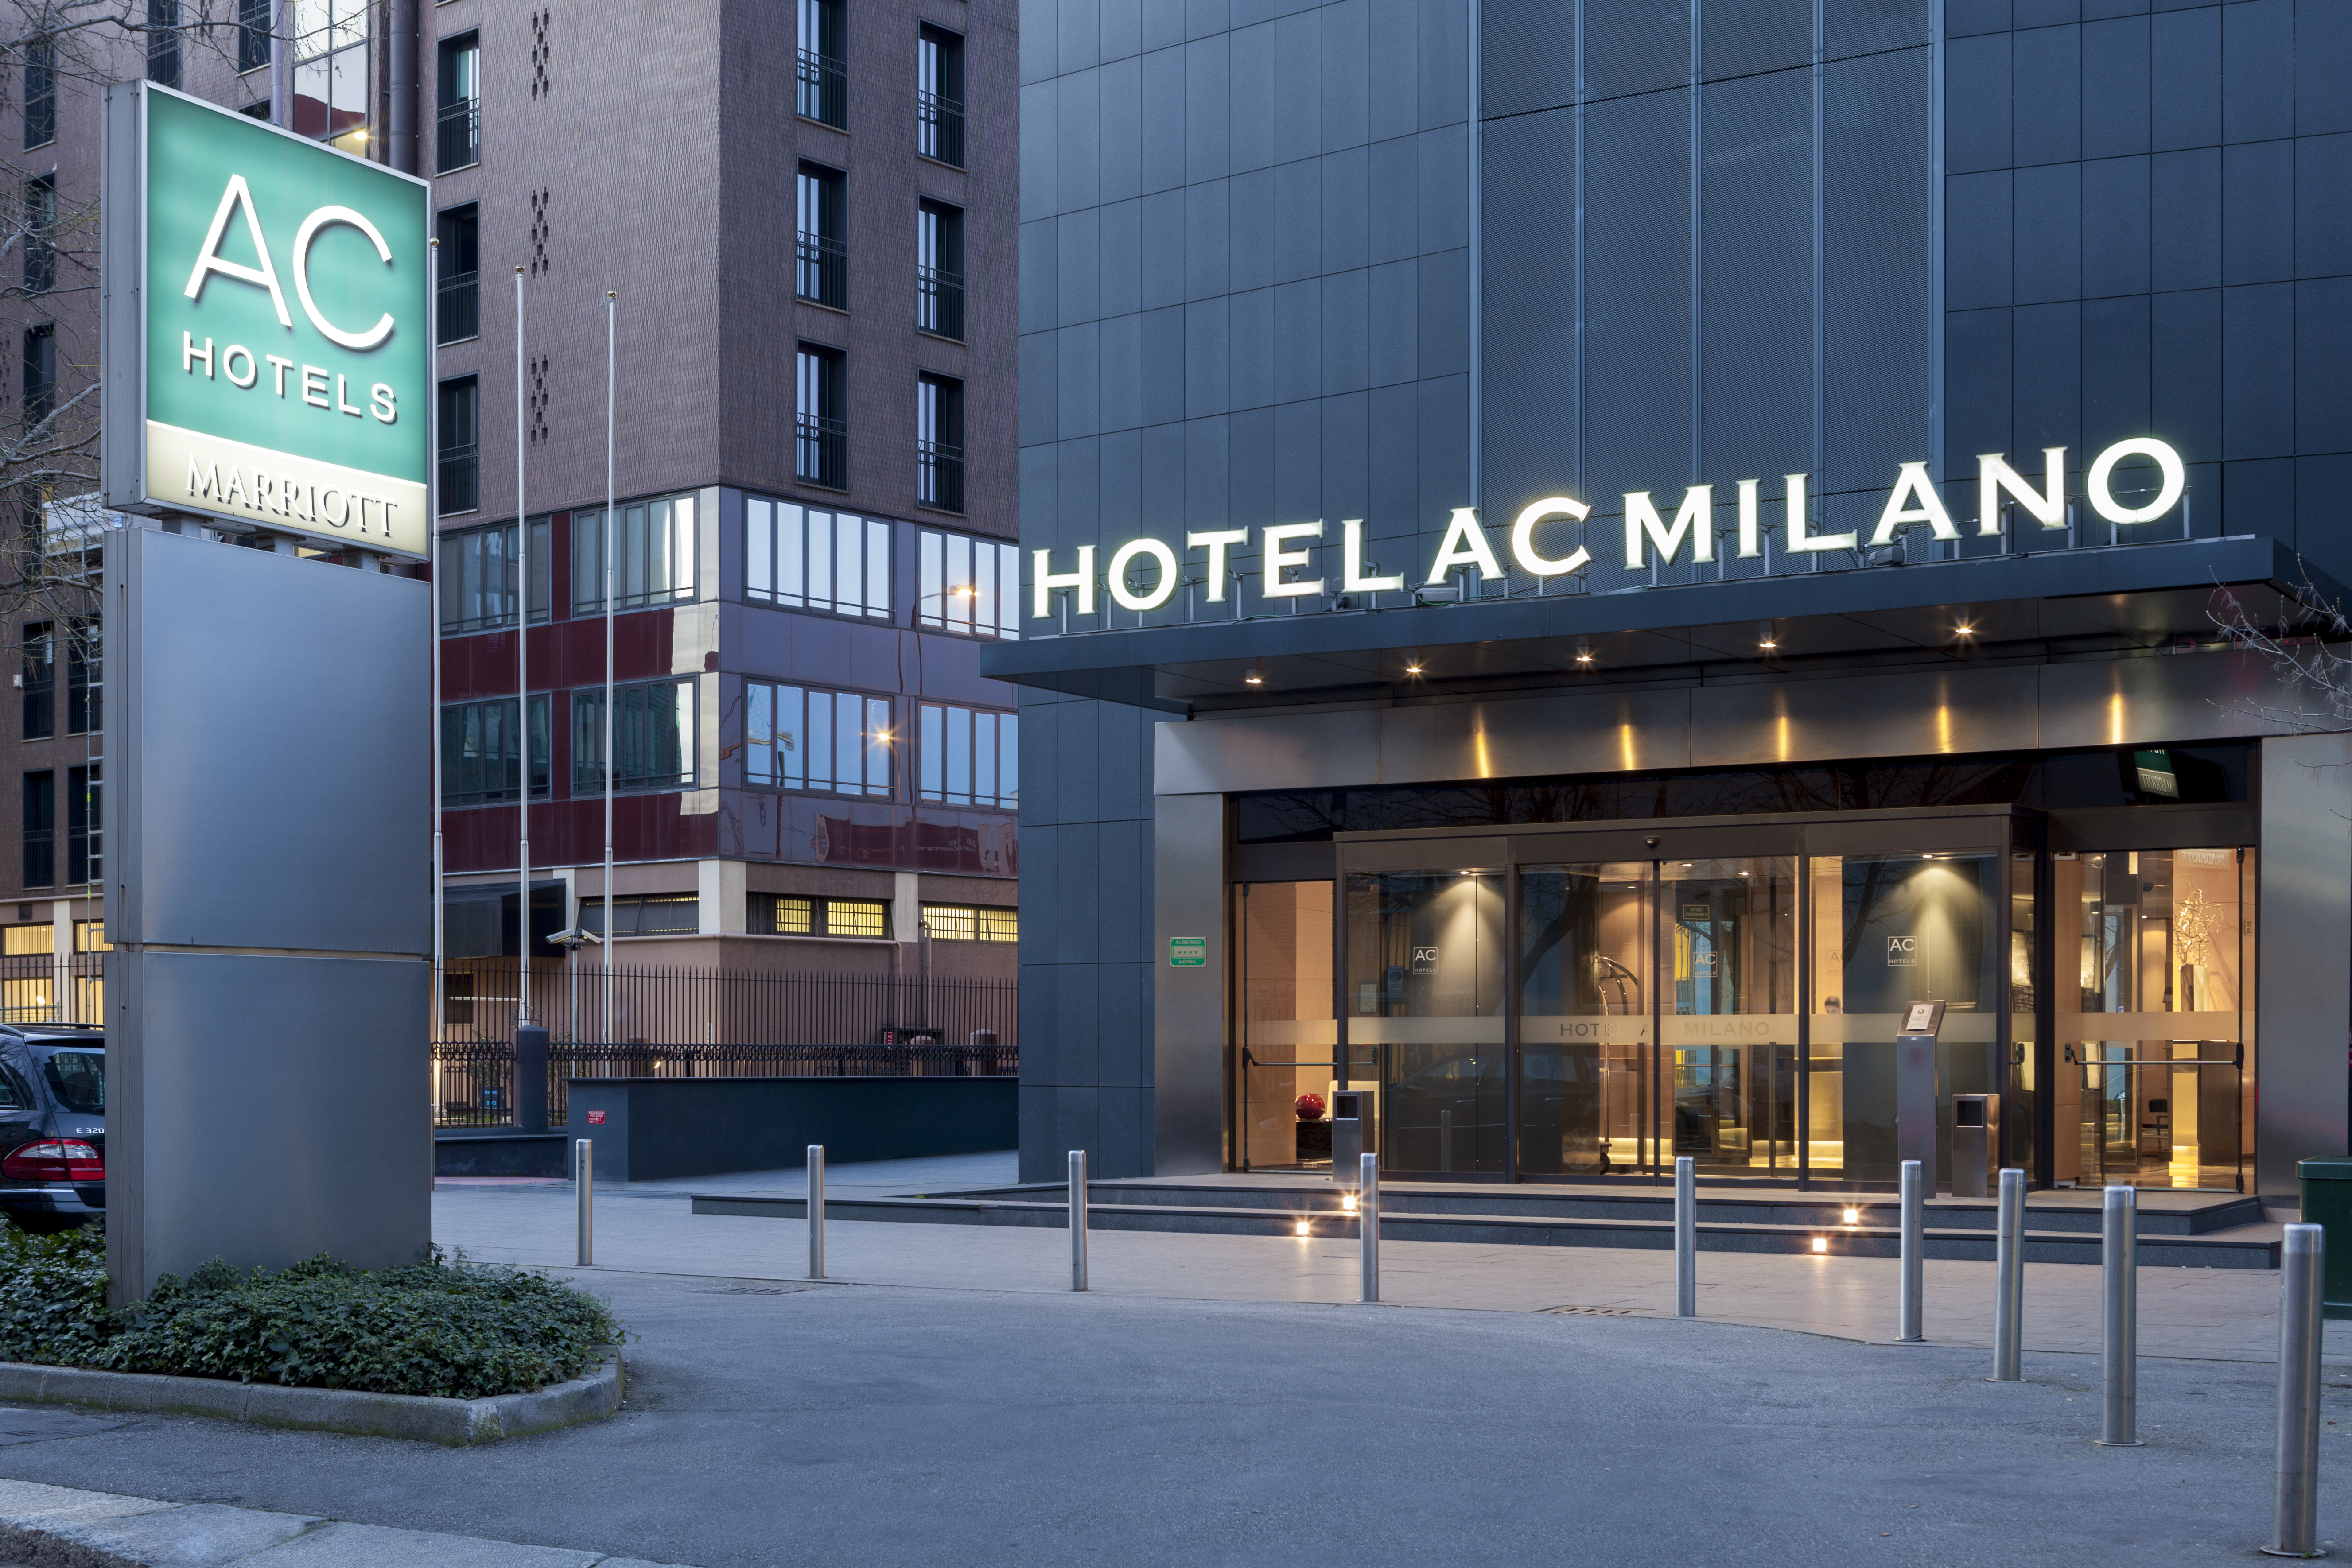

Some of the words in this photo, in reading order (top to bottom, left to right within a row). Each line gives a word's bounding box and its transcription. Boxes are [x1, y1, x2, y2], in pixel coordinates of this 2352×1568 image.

[184, 174, 395, 347] AC
[184, 331, 395, 422] HOTELS
[185, 451, 396, 535] MARRIOTT
[1032, 519, 1404, 618] HOTEL
[1427, 497, 1591, 584] AC
[1624, 437, 2185, 568] MILANO
[1415, 949, 1436, 961] AC
[1695, 953, 1716, 965] AC
[1889, 939, 1915, 951] AC
[1560, 1023, 1624, 1036] HOTEL
[1684, 1021, 1770, 1036] MILANO
